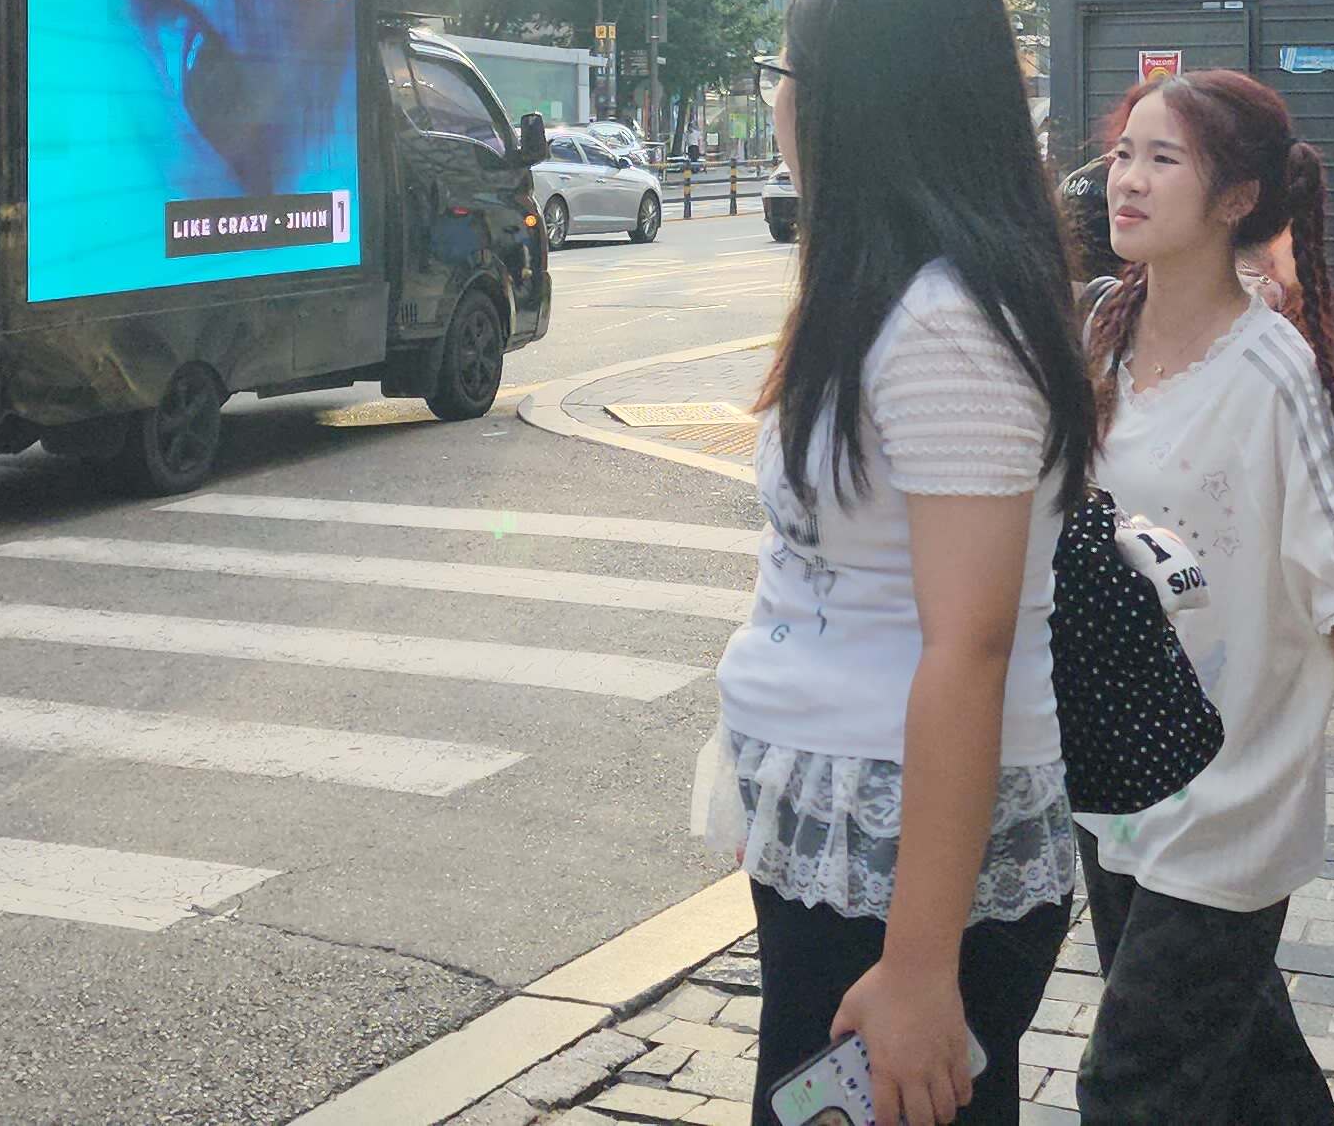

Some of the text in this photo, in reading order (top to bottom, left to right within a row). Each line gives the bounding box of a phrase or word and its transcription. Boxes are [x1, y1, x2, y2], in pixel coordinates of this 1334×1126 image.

[172, 220, 211, 239] LIKE
[217, 214, 268, 235] CRAZY
[286, 209, 328, 230] JIMIN
